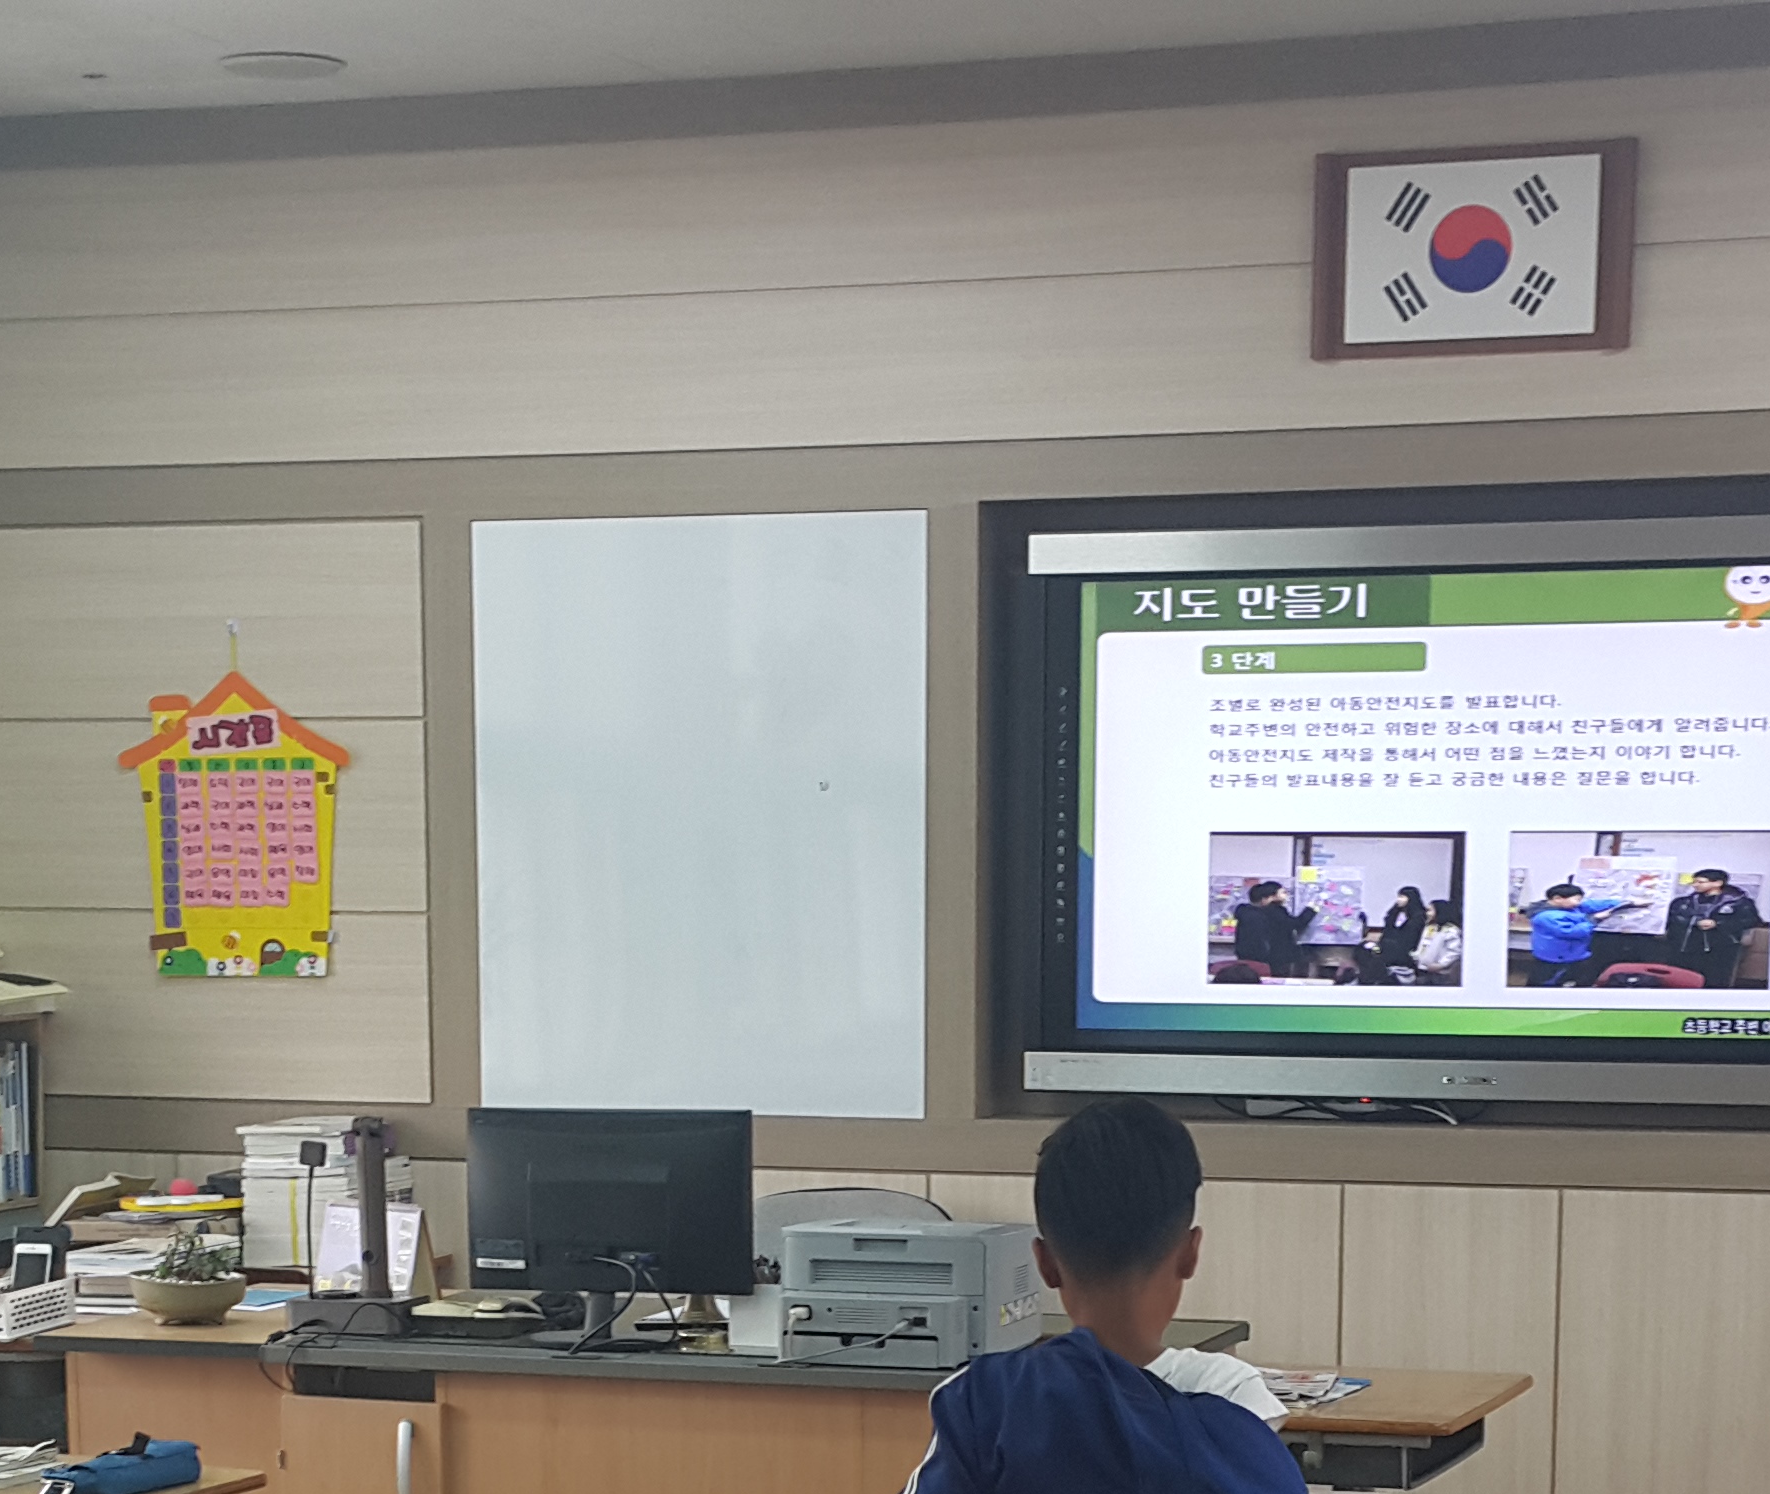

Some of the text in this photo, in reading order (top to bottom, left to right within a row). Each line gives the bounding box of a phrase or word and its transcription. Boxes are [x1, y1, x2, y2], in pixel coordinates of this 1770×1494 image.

[1132, 582, 1368, 623] 지도 만들기
[1209, 650, 1277, 671] 3 단계
[1209, 693, 1563, 713] 조별로 완성된 아동안전지도를 발표합니다.
[1209, 723, 1297, 738] 학교주변의
[1304, 722, 1376, 737] 안전하고
[1383, 721, 1438, 737] 위험한
[1444, 720, 1500, 736] 장소에
[1507, 719, 1563, 735] 대해서
[1570, 717, 1664, 735] 친구들에게
[1208, 748, 1314, 764] 아동안전지도
[1321, 747, 1375, 763] 제작을
[1384, 747, 1437, 762] 통해서
[1444, 746, 1481, 762] 어떤
[1488, 745, 1525, 762] 점을
[1614, 745, 1671, 761] 이야기
[1678, 743, 1742, 760] 합니다.
[1208, 770, 1701, 789] 친구들의 발표내용을 잘 듣고 궁금한 내용은 질문을 합니다.
